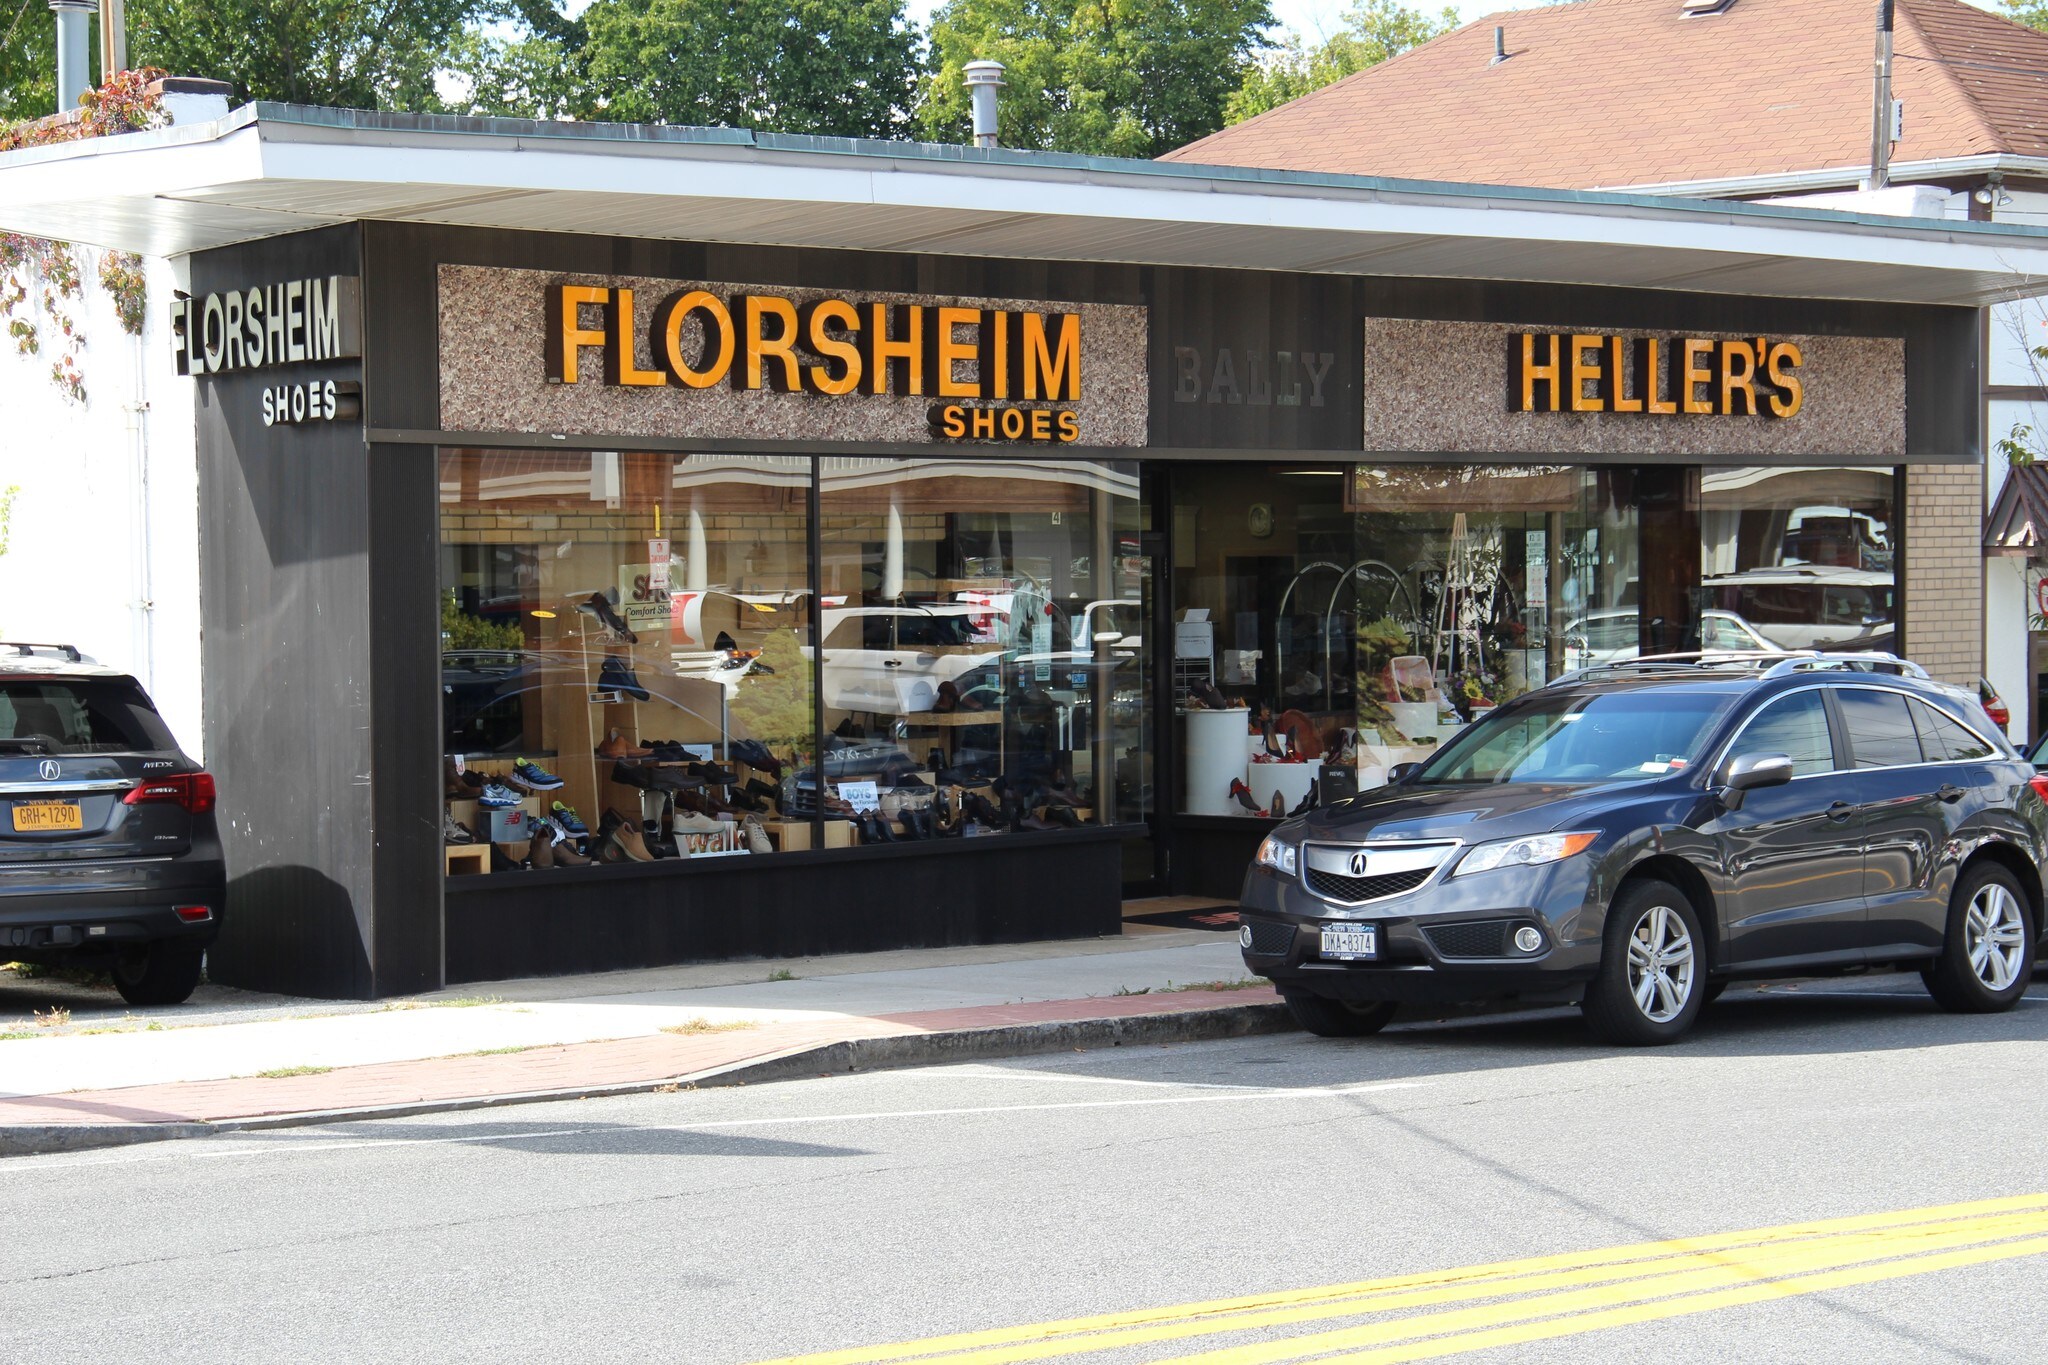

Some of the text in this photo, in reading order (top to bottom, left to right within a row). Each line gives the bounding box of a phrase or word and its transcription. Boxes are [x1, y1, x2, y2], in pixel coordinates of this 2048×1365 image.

[170, 275, 340, 376] FLORSHEIM
[561, 285, 1081, 401] FLORSHEIM
[1174, 346, 1334, 407] BALLY
[1522, 333, 1802, 418] HELLER'S
[262, 379, 336, 427] SHOES
[943, 404, 1080, 442] SHOES
[626, 606, 656, 617] Comfort
[845, 788, 872, 800] BOYS
